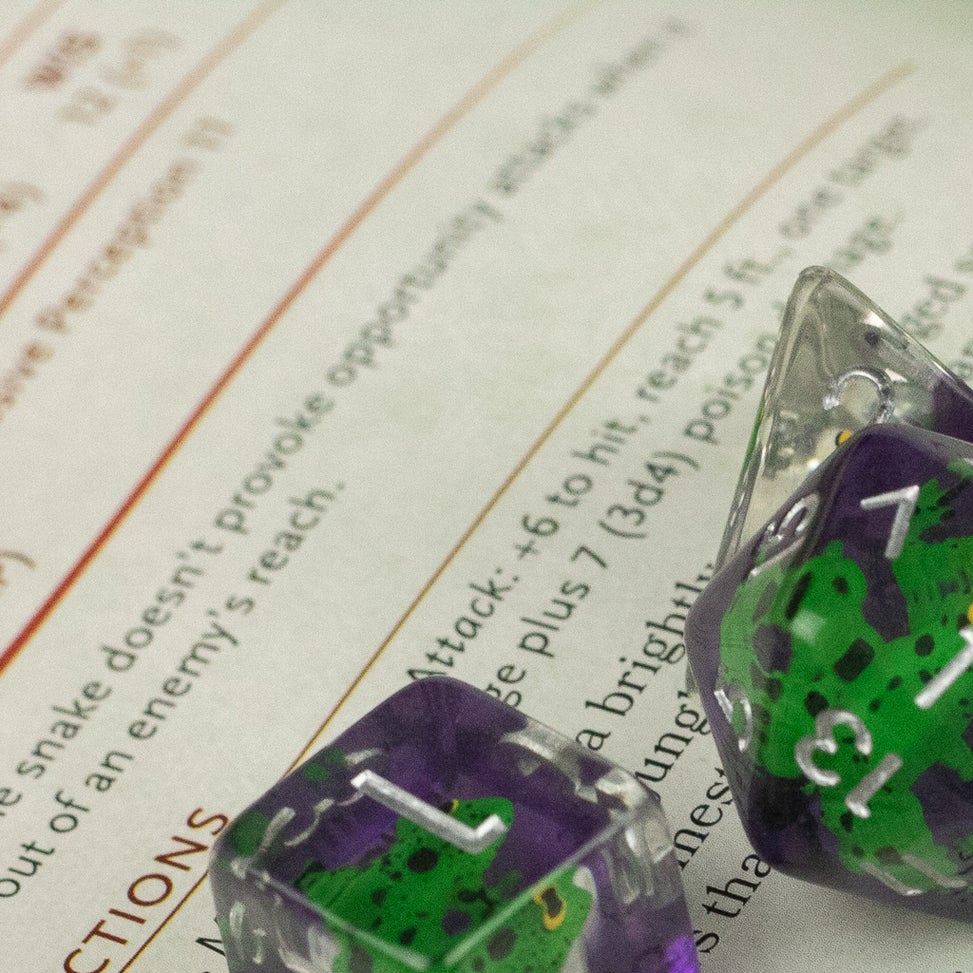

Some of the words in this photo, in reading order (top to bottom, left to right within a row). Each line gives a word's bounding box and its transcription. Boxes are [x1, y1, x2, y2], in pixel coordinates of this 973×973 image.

[16, 679, 112, 779] snake
[102, 540, 224, 673] doesn't
[213, 391, 335, 536] provoke
[325, 198, 503, 387] opportunity
[514, 513, 560, 560] +6
[546, 473, 594, 509] to
[571, 415, 651, 466] hit,
[636, 314, 723, 403] reach
[518, 580, 590, 658] plus
[571, 545, 608, 571] 7
[598, 451, 700, 540] (3d4)
[683, 333, 778, 446] poison
[859, 485, 921, 560] 7
[0, 841, 55, 898] out
[50, 789, 90, 834] of
[85, 749, 134, 793] an
[127, 594, 256, 741] enemy's
[247, 481, 346, 586] reach.
[575, 726, 612, 752] a
